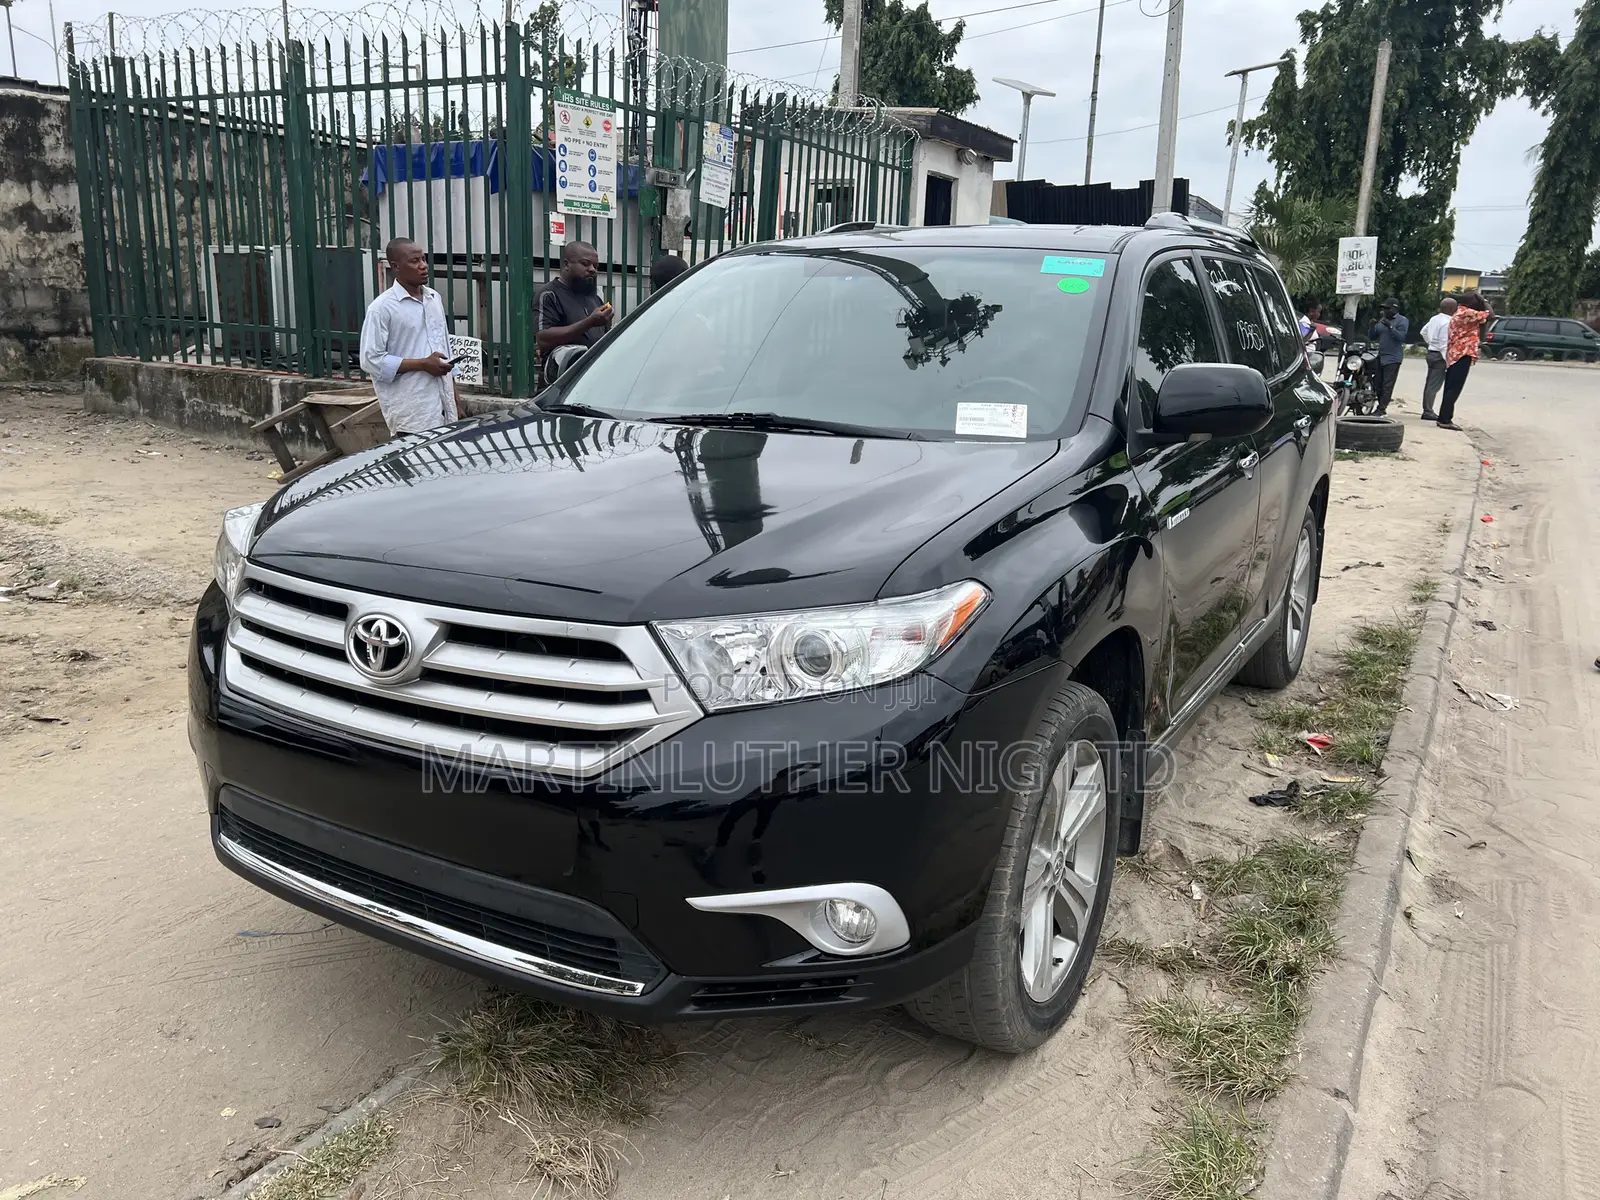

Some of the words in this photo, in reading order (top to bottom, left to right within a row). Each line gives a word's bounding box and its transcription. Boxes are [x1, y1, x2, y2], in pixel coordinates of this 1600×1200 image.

[562, 93, 574, 103] IHS
[575, 97, 589, 106] SITE
[590, 101, 609, 110] RULES
